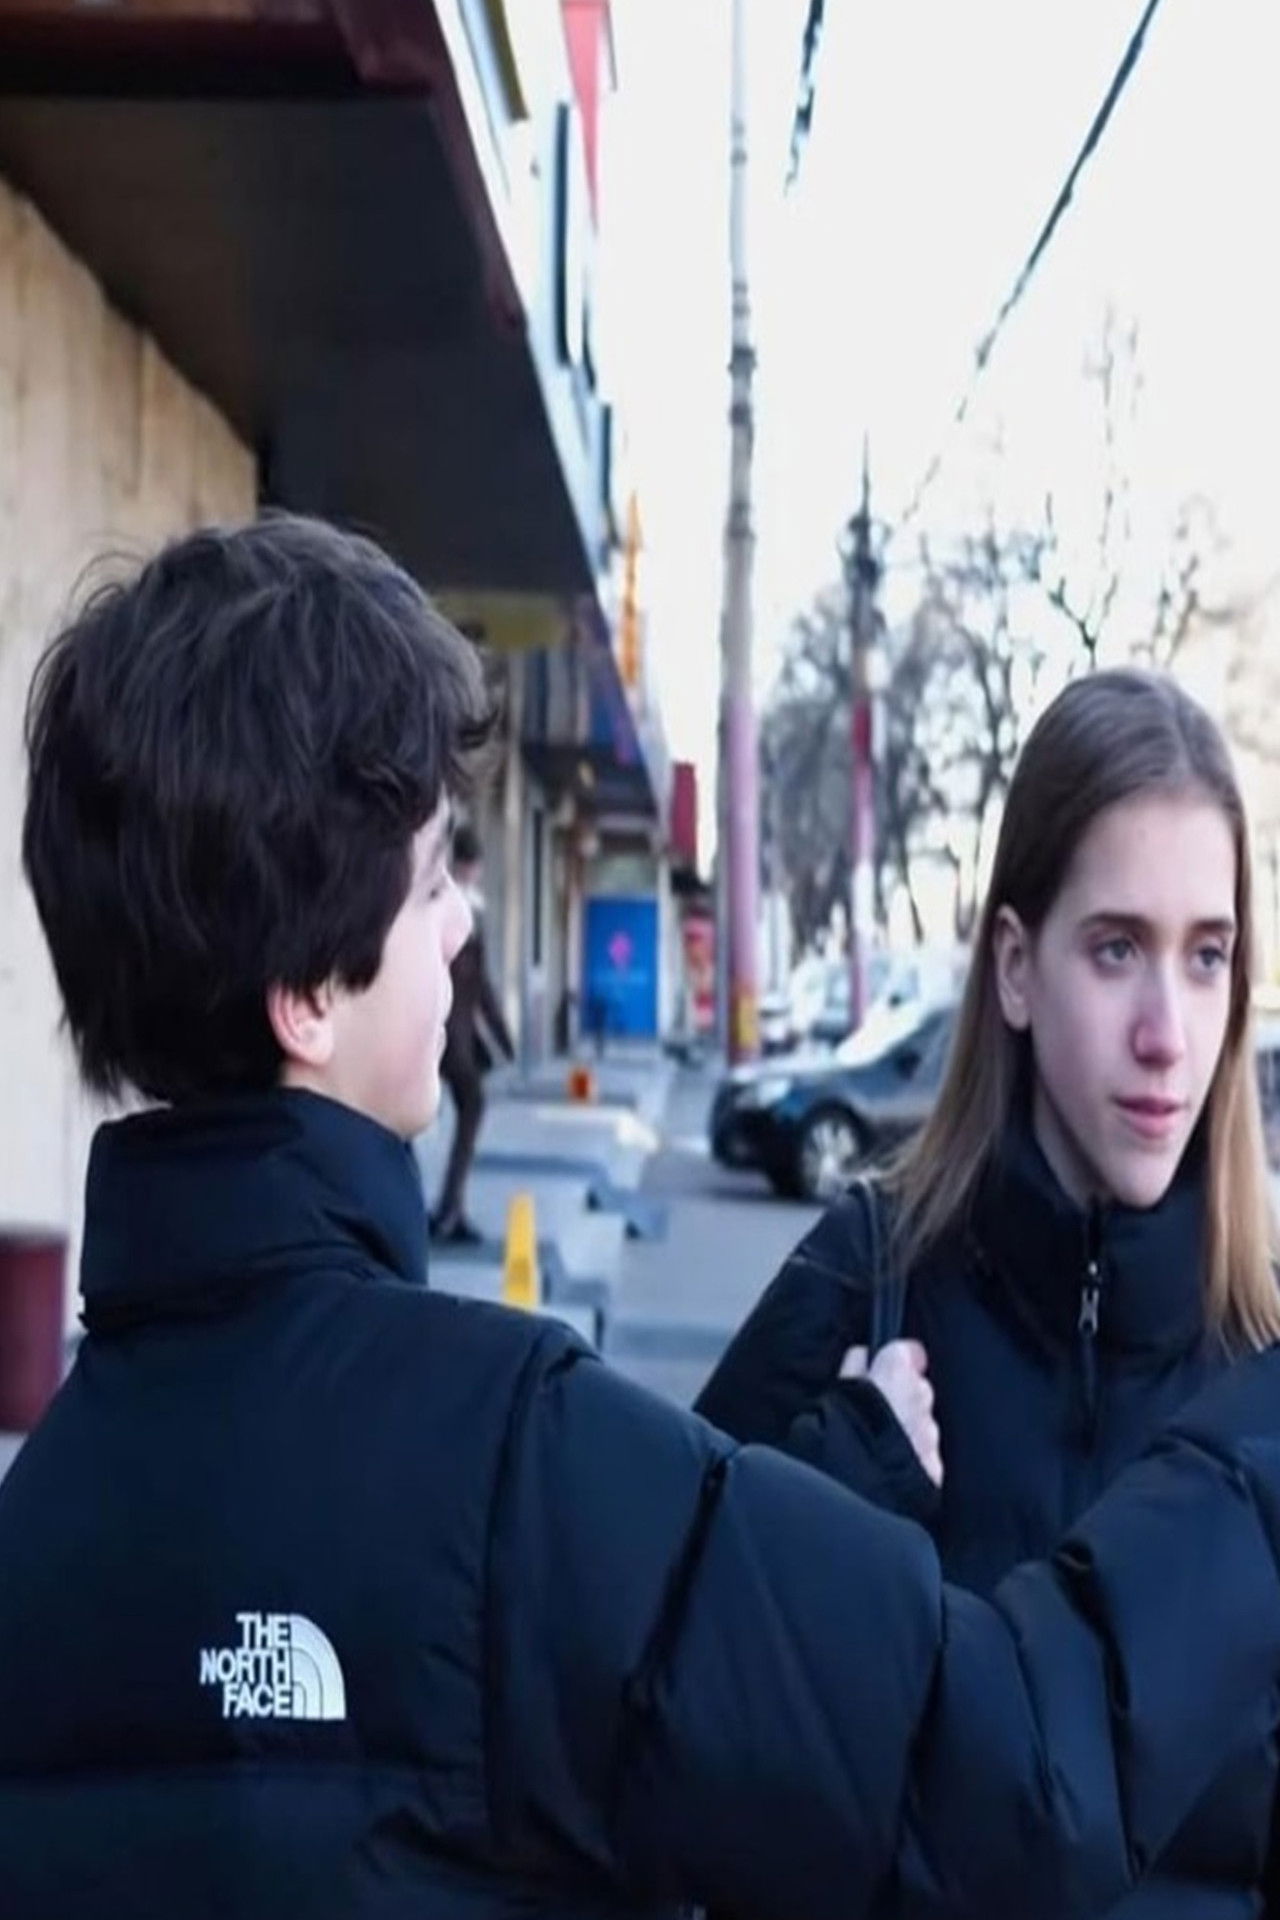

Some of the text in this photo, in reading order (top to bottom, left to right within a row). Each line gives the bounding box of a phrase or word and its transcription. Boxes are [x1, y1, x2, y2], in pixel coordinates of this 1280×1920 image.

[236, 1612, 289, 1648] THE
[200, 1649, 291, 1684] NORTH
[223, 1684, 291, 1718] FACE
